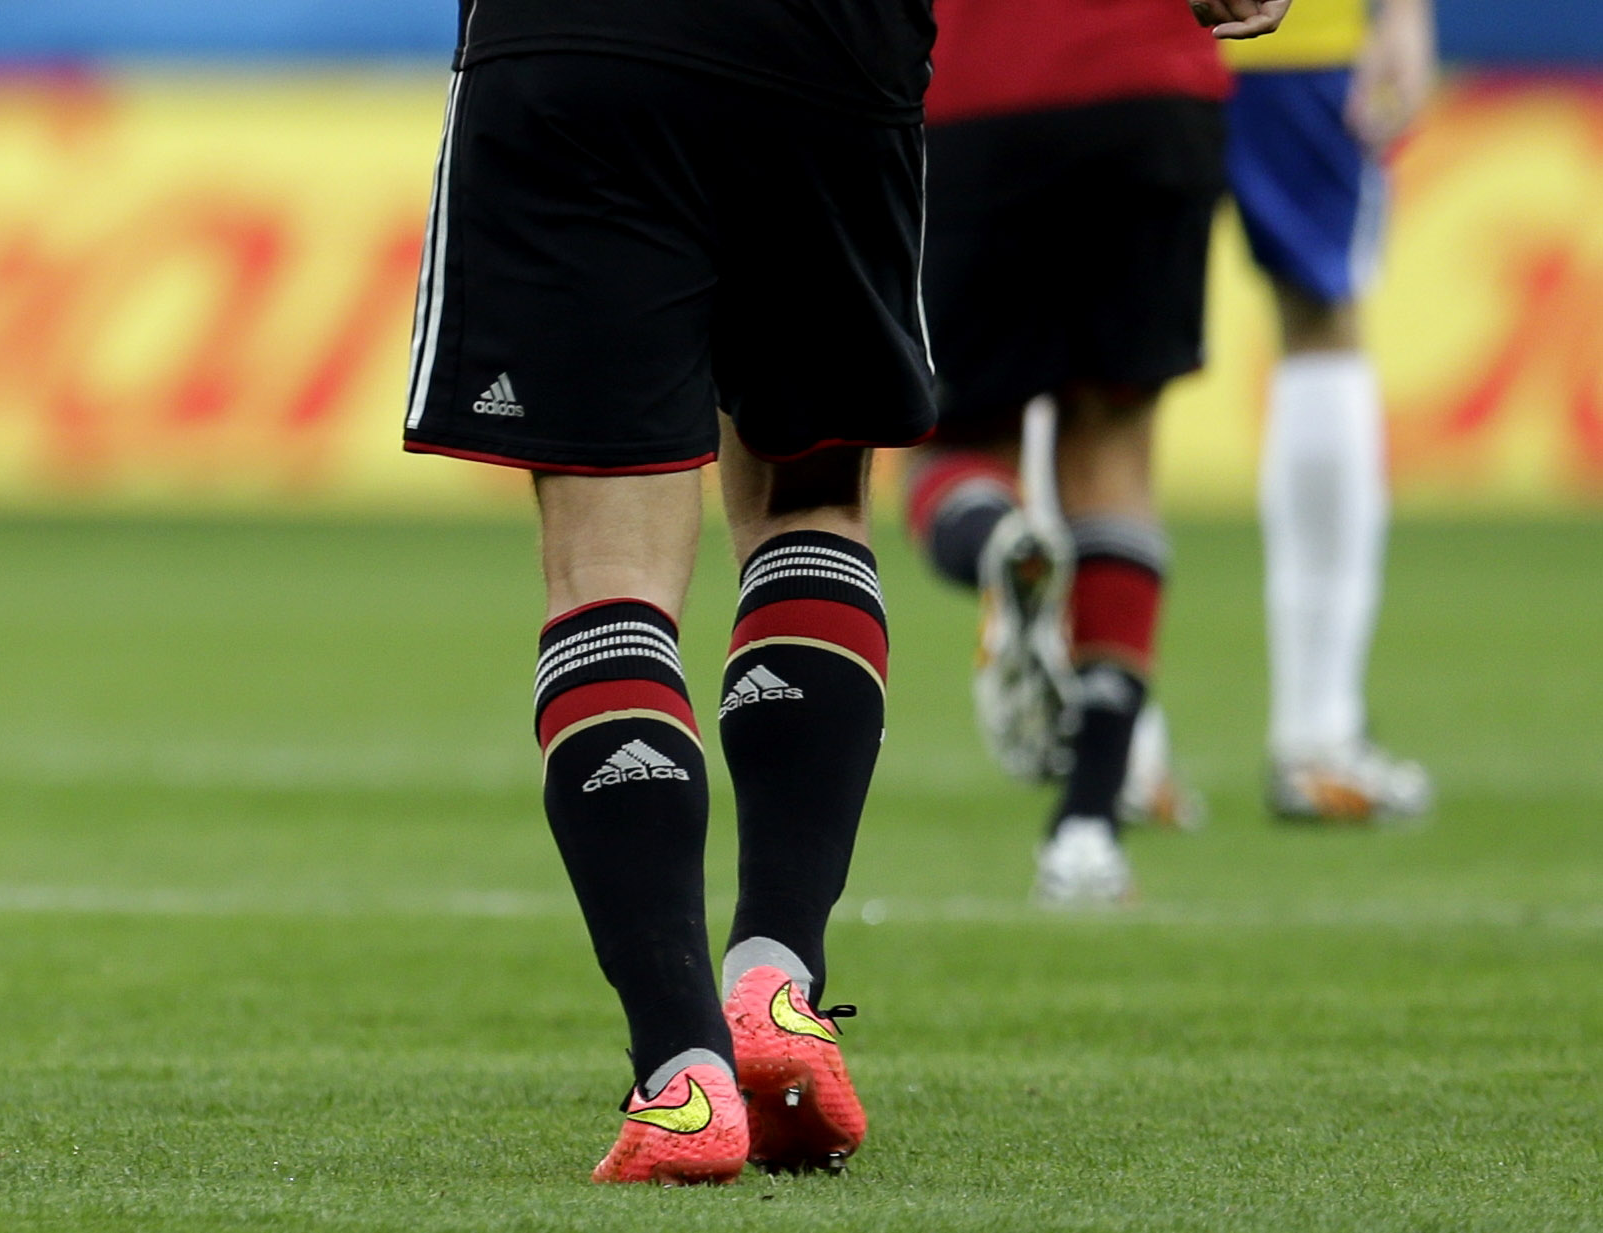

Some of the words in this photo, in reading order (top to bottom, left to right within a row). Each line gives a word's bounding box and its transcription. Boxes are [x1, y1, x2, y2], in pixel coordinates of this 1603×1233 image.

[472, 398, 525, 418] adidas
[718, 686, 804, 719] adidas
[582, 765, 691, 793] adidas
